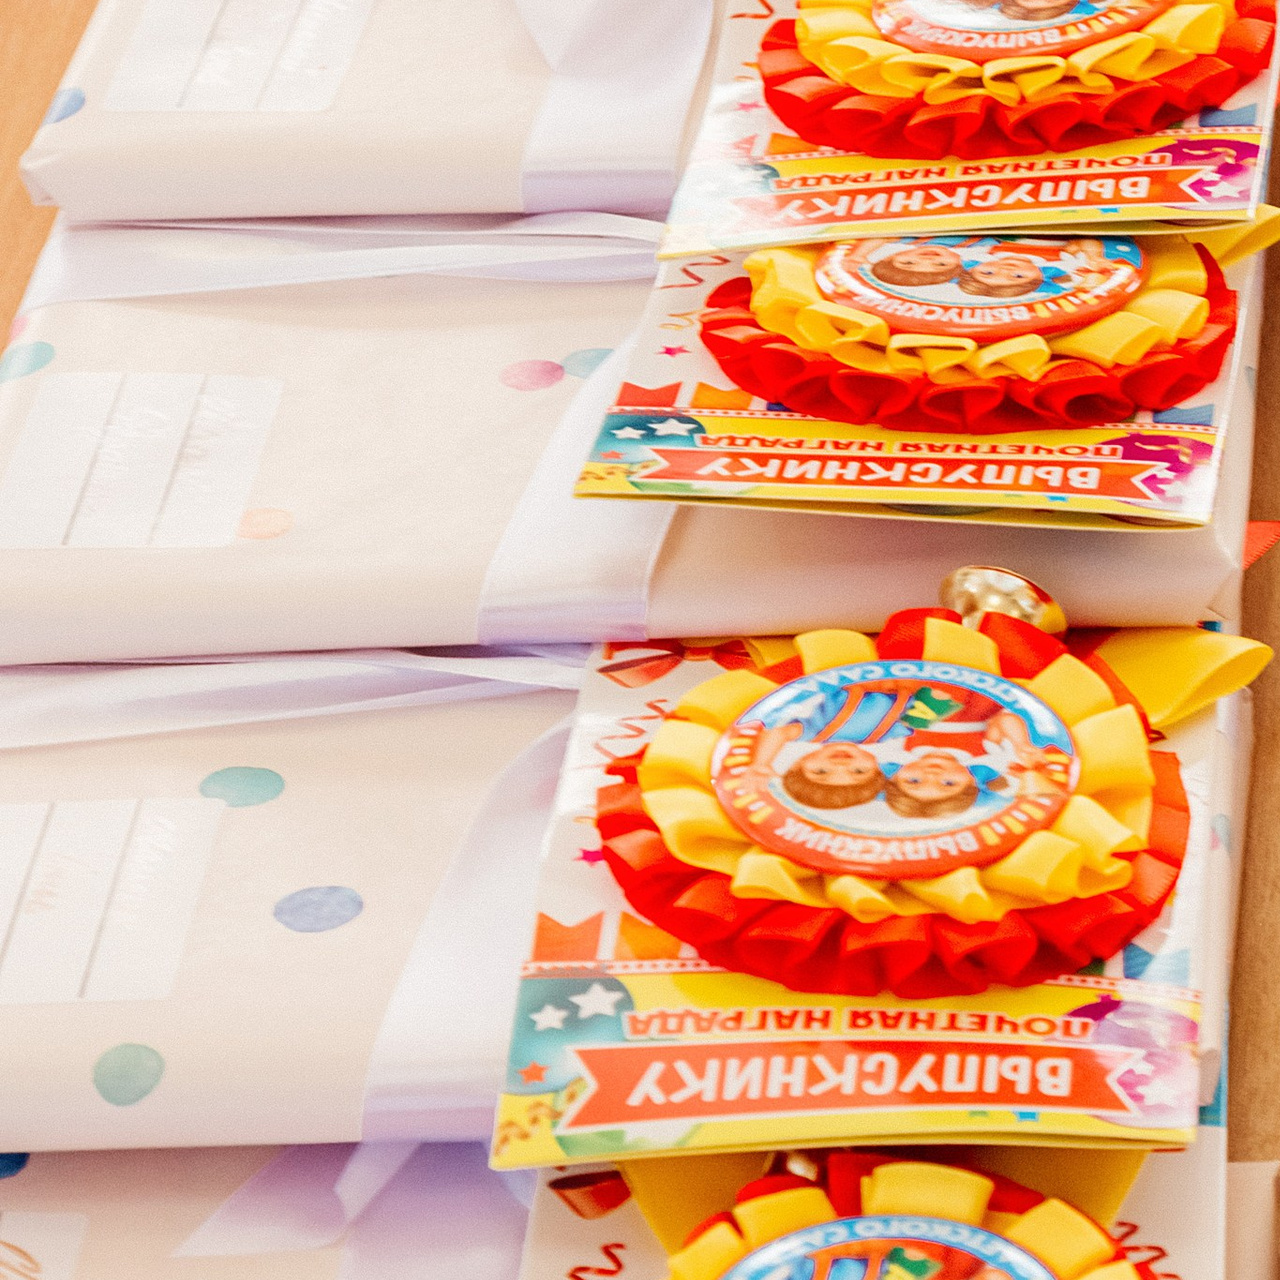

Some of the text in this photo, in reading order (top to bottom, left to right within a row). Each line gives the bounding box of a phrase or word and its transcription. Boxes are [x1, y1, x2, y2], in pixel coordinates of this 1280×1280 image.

[775, 154, 1167, 188] ПОЧЕТНАЯ НАГРАДА
[778, 176, 1151, 220] ВЫПУСКНИКУ
[701, 434, 1122, 458] ПОЧЕТНАЯ НАГРАДА
[698, 457, 1100, 489] ВЫПУСКНИКУ
[775, 817, 980, 864] ВЫПУСКНИК
[629, 1008, 1091, 1038] ПОЧЕТНАЯ НАГРАДА
[626, 1053, 1073, 1106] ВЫПУСКНИКУ
